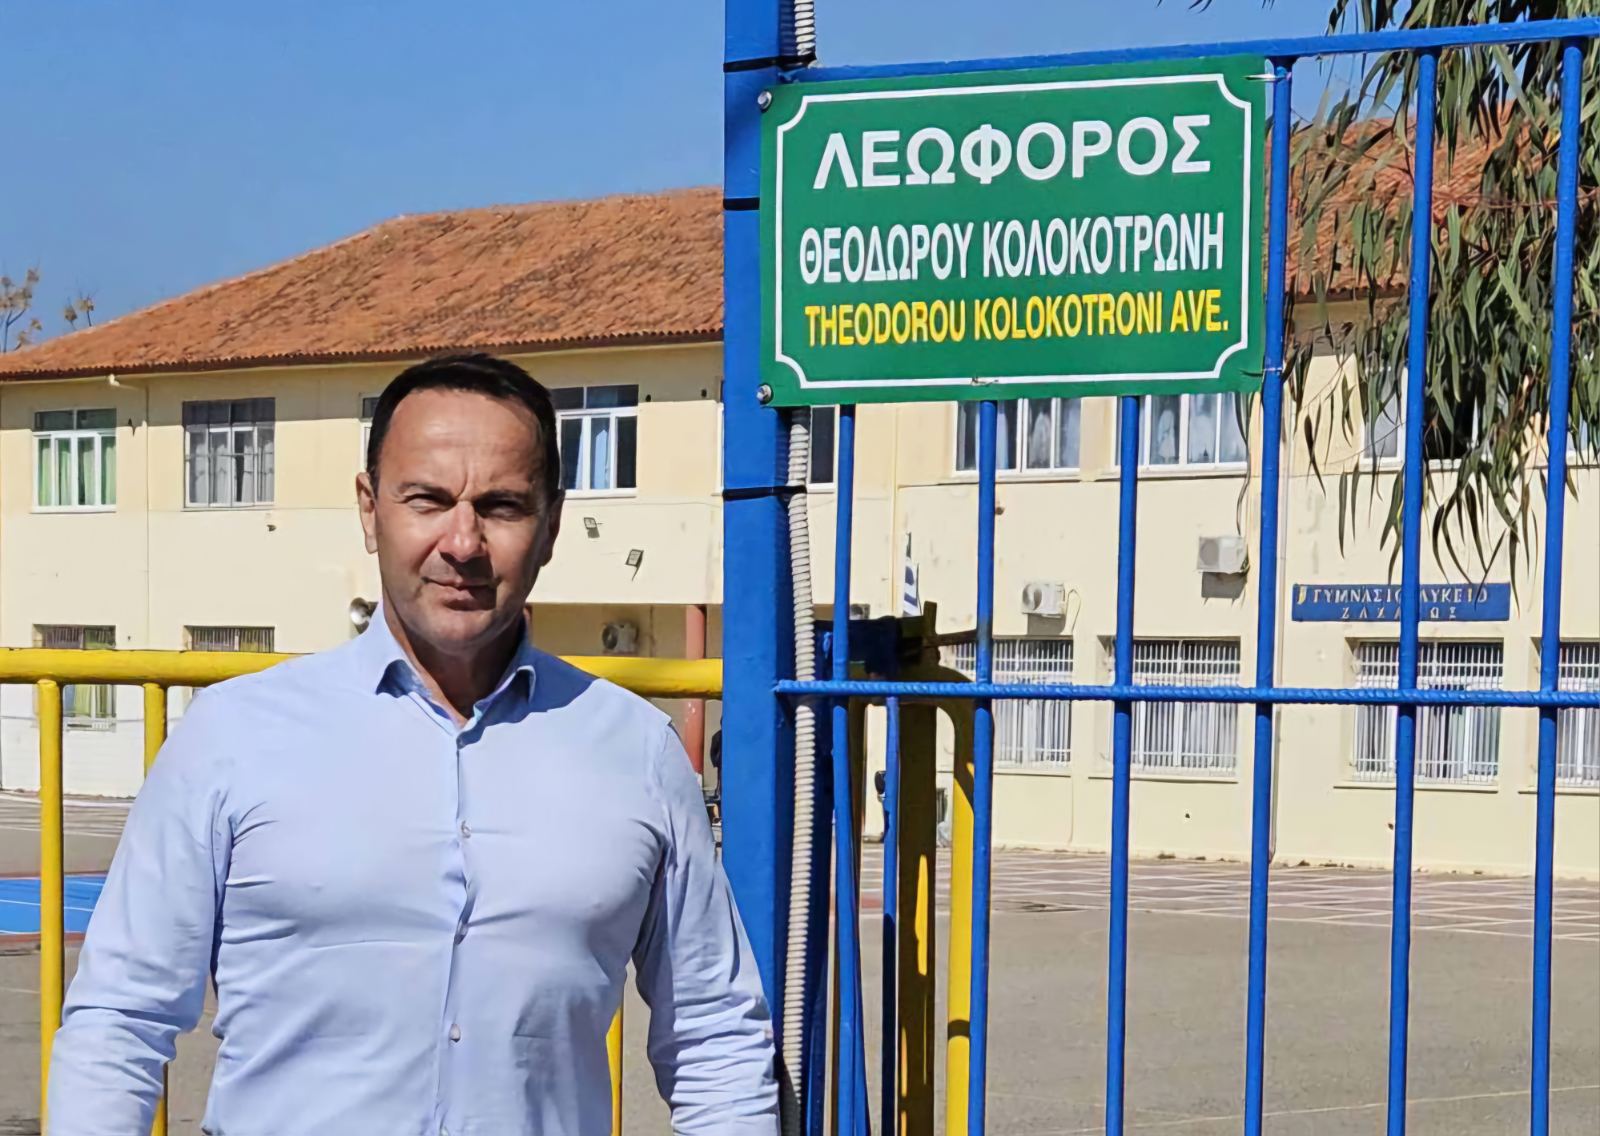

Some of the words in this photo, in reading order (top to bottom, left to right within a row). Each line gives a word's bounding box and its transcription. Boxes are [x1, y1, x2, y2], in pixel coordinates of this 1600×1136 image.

[813, 114, 1211, 190] ΛΕΩΦΟΡΟΣ
[799, 222, 974, 284] ΘΕΟΔΩΡΟΥ
[983, 212, 1225, 278] ΚΟΛΟΚΟΤΡΩΝΗ
[804, 298, 966, 347] THEODOROU
[974, 290, 1163, 342] KOLOKOTRONI
[1170, 289, 1229, 333] AVE.
